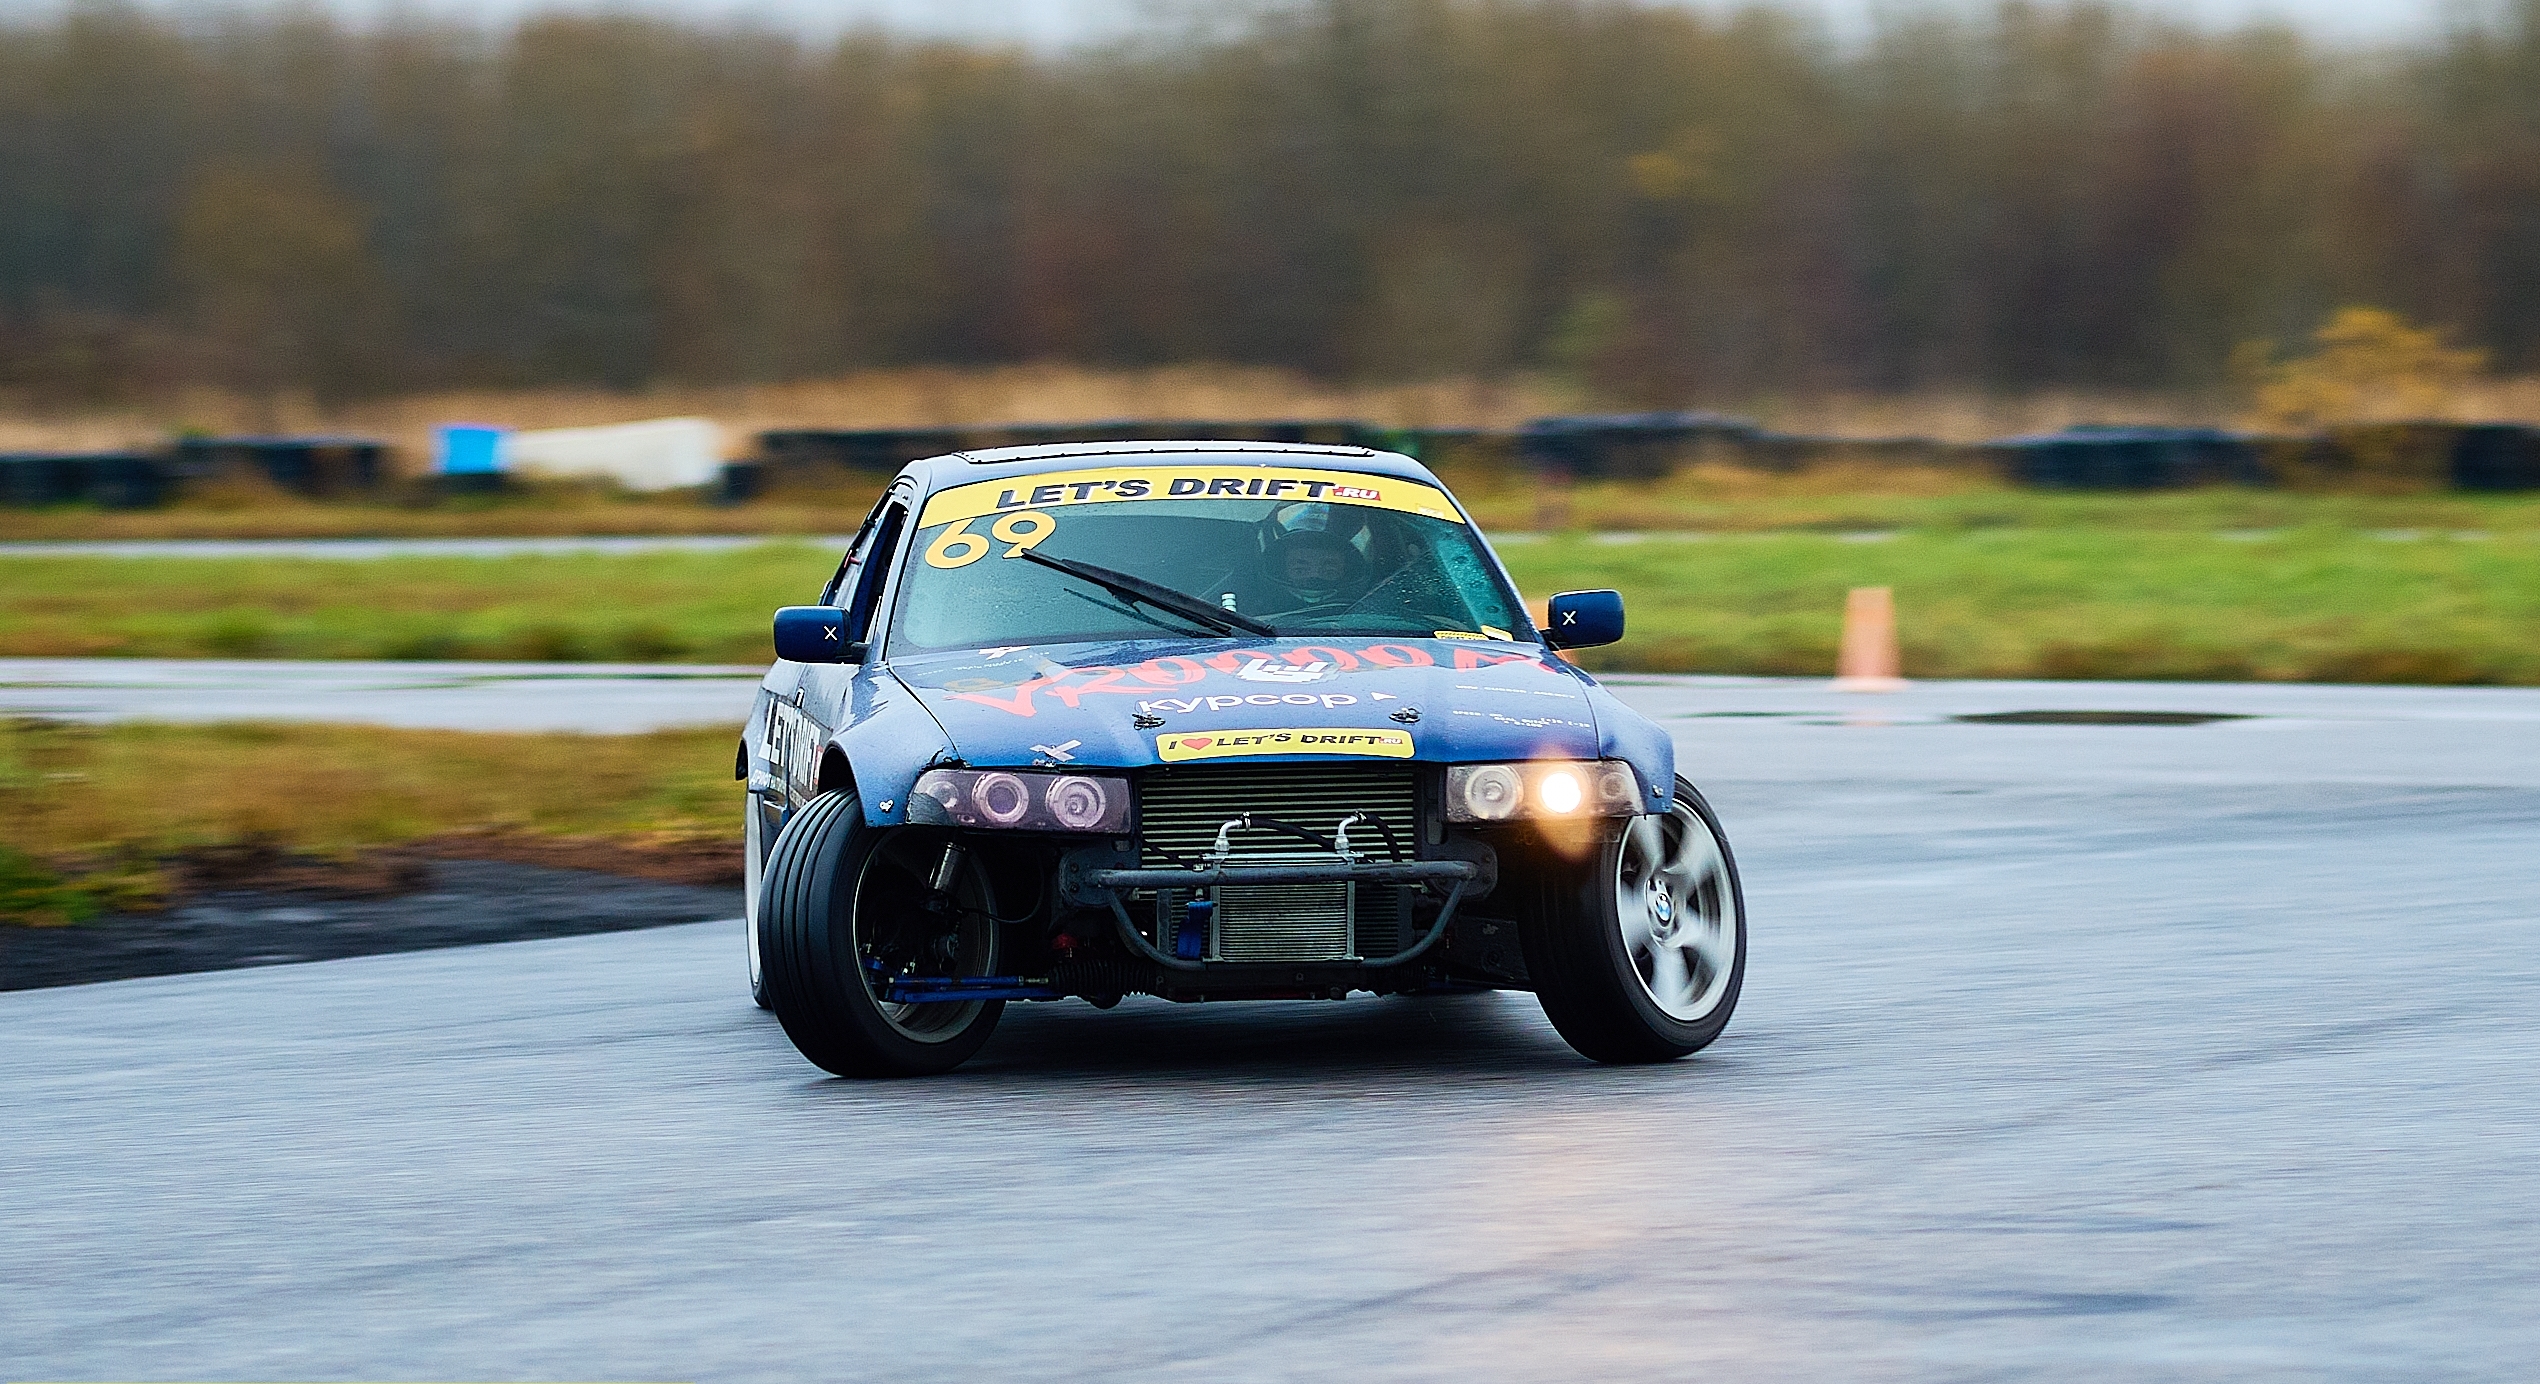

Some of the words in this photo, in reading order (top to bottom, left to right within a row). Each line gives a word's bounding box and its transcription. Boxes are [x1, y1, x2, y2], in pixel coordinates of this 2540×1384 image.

[995, 478, 1150, 509] LET'S
[924, 510, 1057, 570] 69
[1168, 740, 1178, 750] I
[1216, 733, 1292, 746] LET'S
